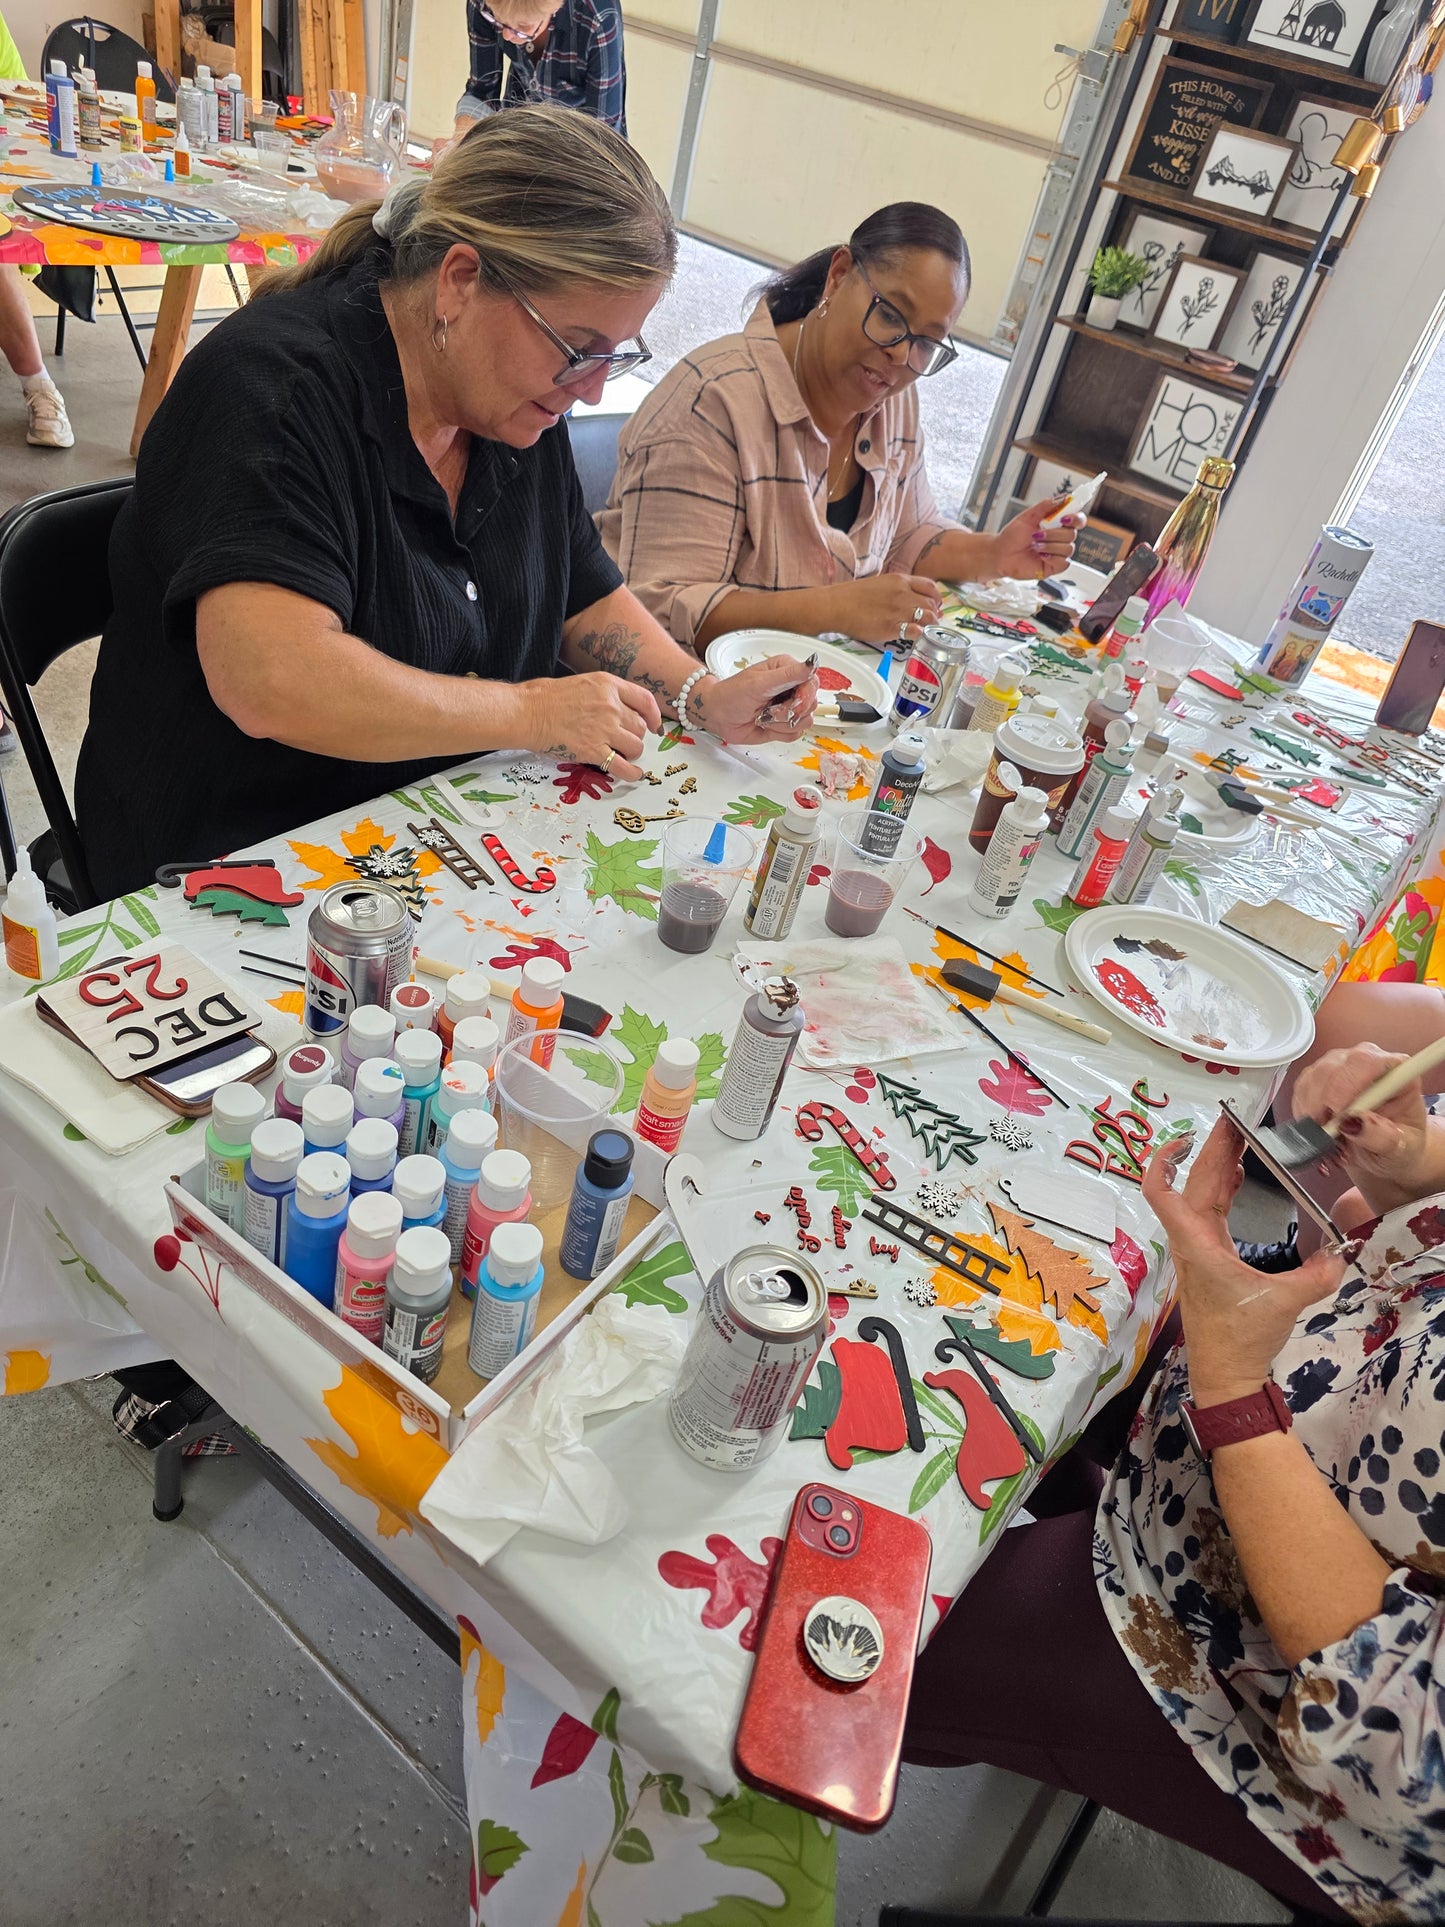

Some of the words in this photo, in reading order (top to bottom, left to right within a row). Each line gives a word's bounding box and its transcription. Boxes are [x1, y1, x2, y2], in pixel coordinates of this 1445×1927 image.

[1169, 80, 1198, 94] THIS
[1199, 81, 1236, 104] HOME
[1233, 99, 1245, 112] IS
[1180, 94, 1206, 106] FILLED
[1206, 99, 1228, 112] WITH
[1169, 119, 1210, 141] KISSE
[1148, 162, 1174, 181] AND
[1175, 174, 1190, 185] LO
[901, 675, 938, 704] EPSI
[79, 953, 188, 1023] 25
[309, 980, 347, 1014] PSI
[115, 991, 247, 1062] DEC
[294, 1051, 321, 1067] Burgundy
[640, 1110, 658, 1126] craft
[659, 1118, 685, 1128] smart
[869, 1235, 900, 1263] key
[350, 1310, 373, 1318] Candy
[721, 1314, 737, 1335] Facts
[711, 1314, 733, 1344] nutritive
[401, 1393, 432, 1425] 36
